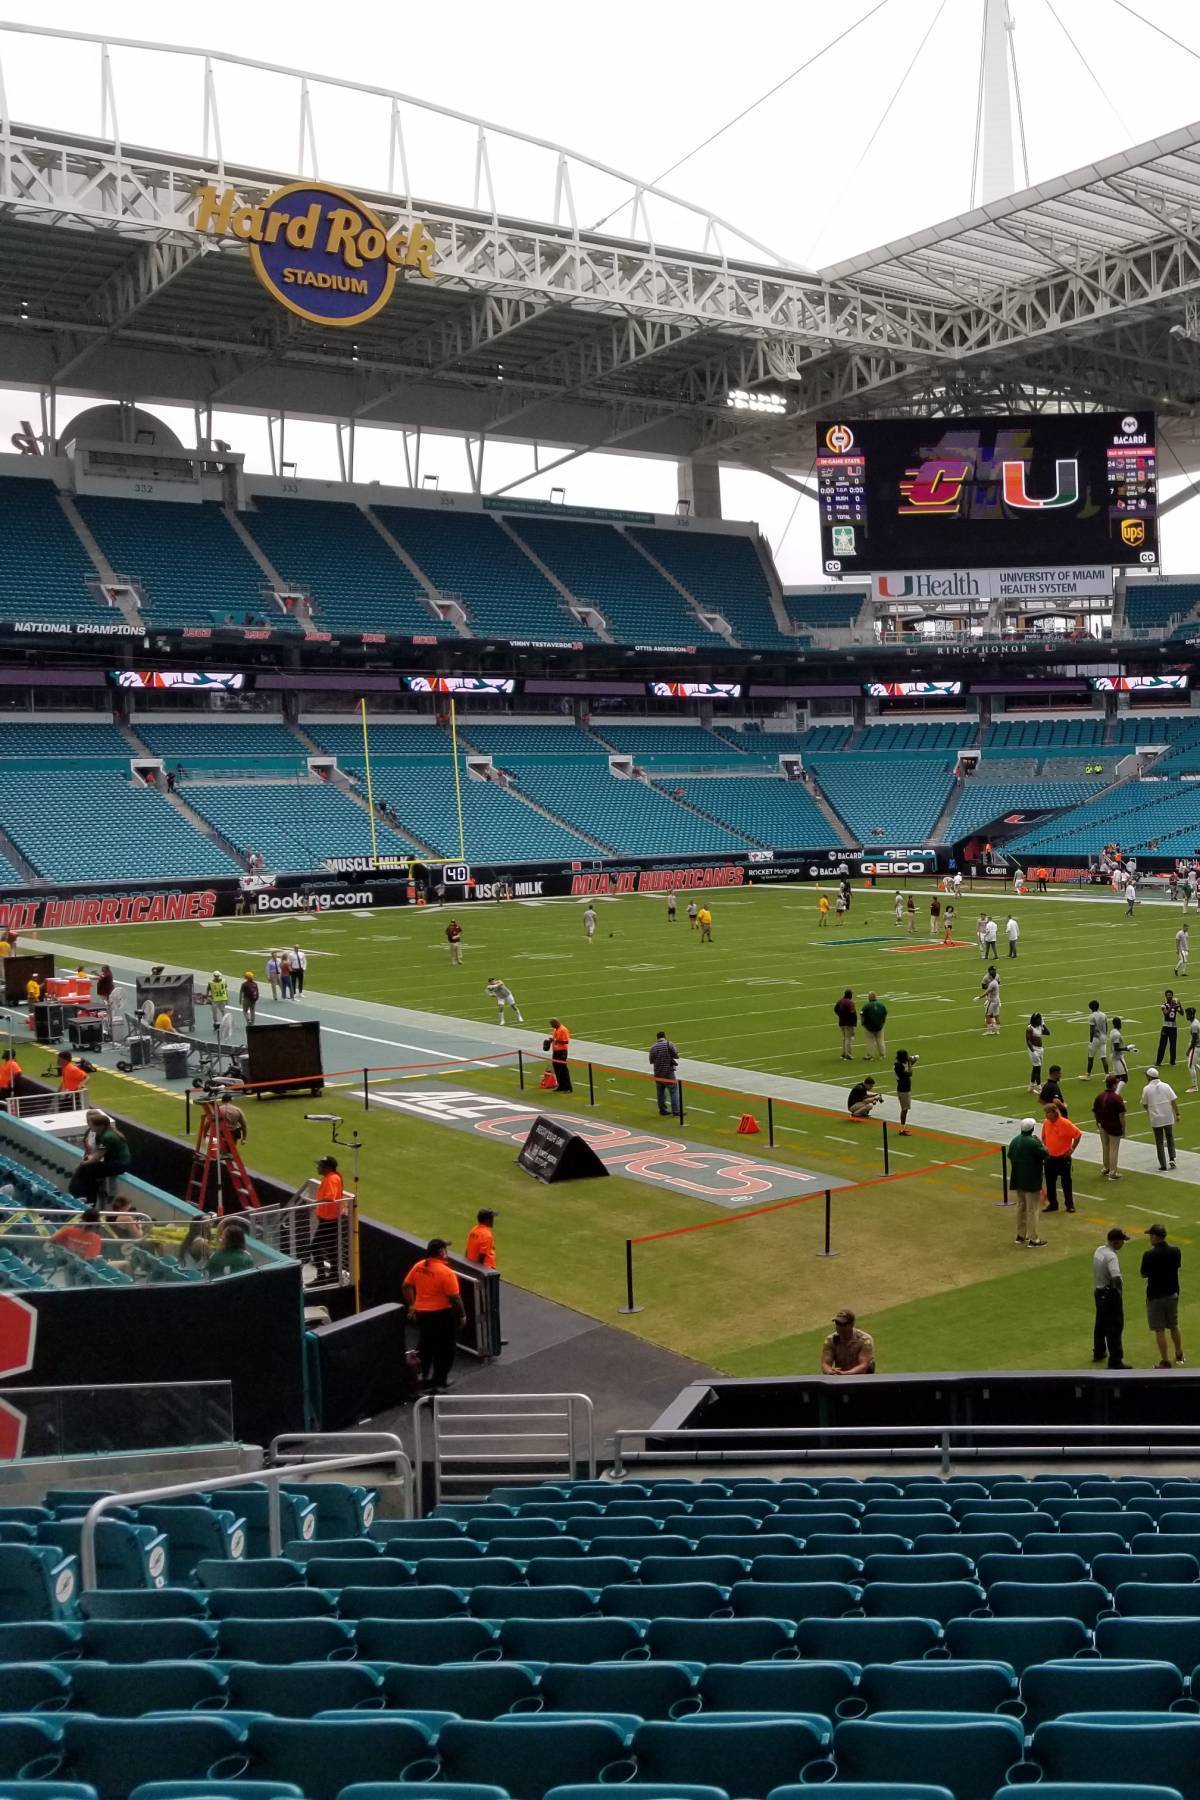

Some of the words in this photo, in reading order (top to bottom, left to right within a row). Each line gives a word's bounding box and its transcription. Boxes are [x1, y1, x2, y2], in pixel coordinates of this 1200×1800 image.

[196, 186, 323, 250] Hard
[325, 208, 437, 279] Rock
[282, 267, 368, 295] STADIUM
[1123, 527, 1143, 542] ups
[999, 572, 1049, 583] UNIVERSITY
[1051, 571, 1062, 582] OF
[1065, 569, 1106, 581] MIAMI
[1000, 584, 1037, 595] HEALTH
[1038, 583, 1077, 594] SYSTEM
[14, 621, 73, 633] NATIONAL
[76, 623, 146, 636] CHAMPIONS
[937, 646, 969, 655] RING
[981, 645, 1028, 654] HONOR
[326, 857, 376, 873] MUSCLE
[379, 856, 410, 870] MILK
[749, 868, 773, 876] ROCKET
[774, 867, 800, 876] Mortgage
[985, 866, 1007, 875] Canon
[446, 867, 467, 881] 40
[638, 866, 745, 893] HURRICANES
[515, 881, 543, 896] MILK
[42, 889, 217, 929] HURRICANES
